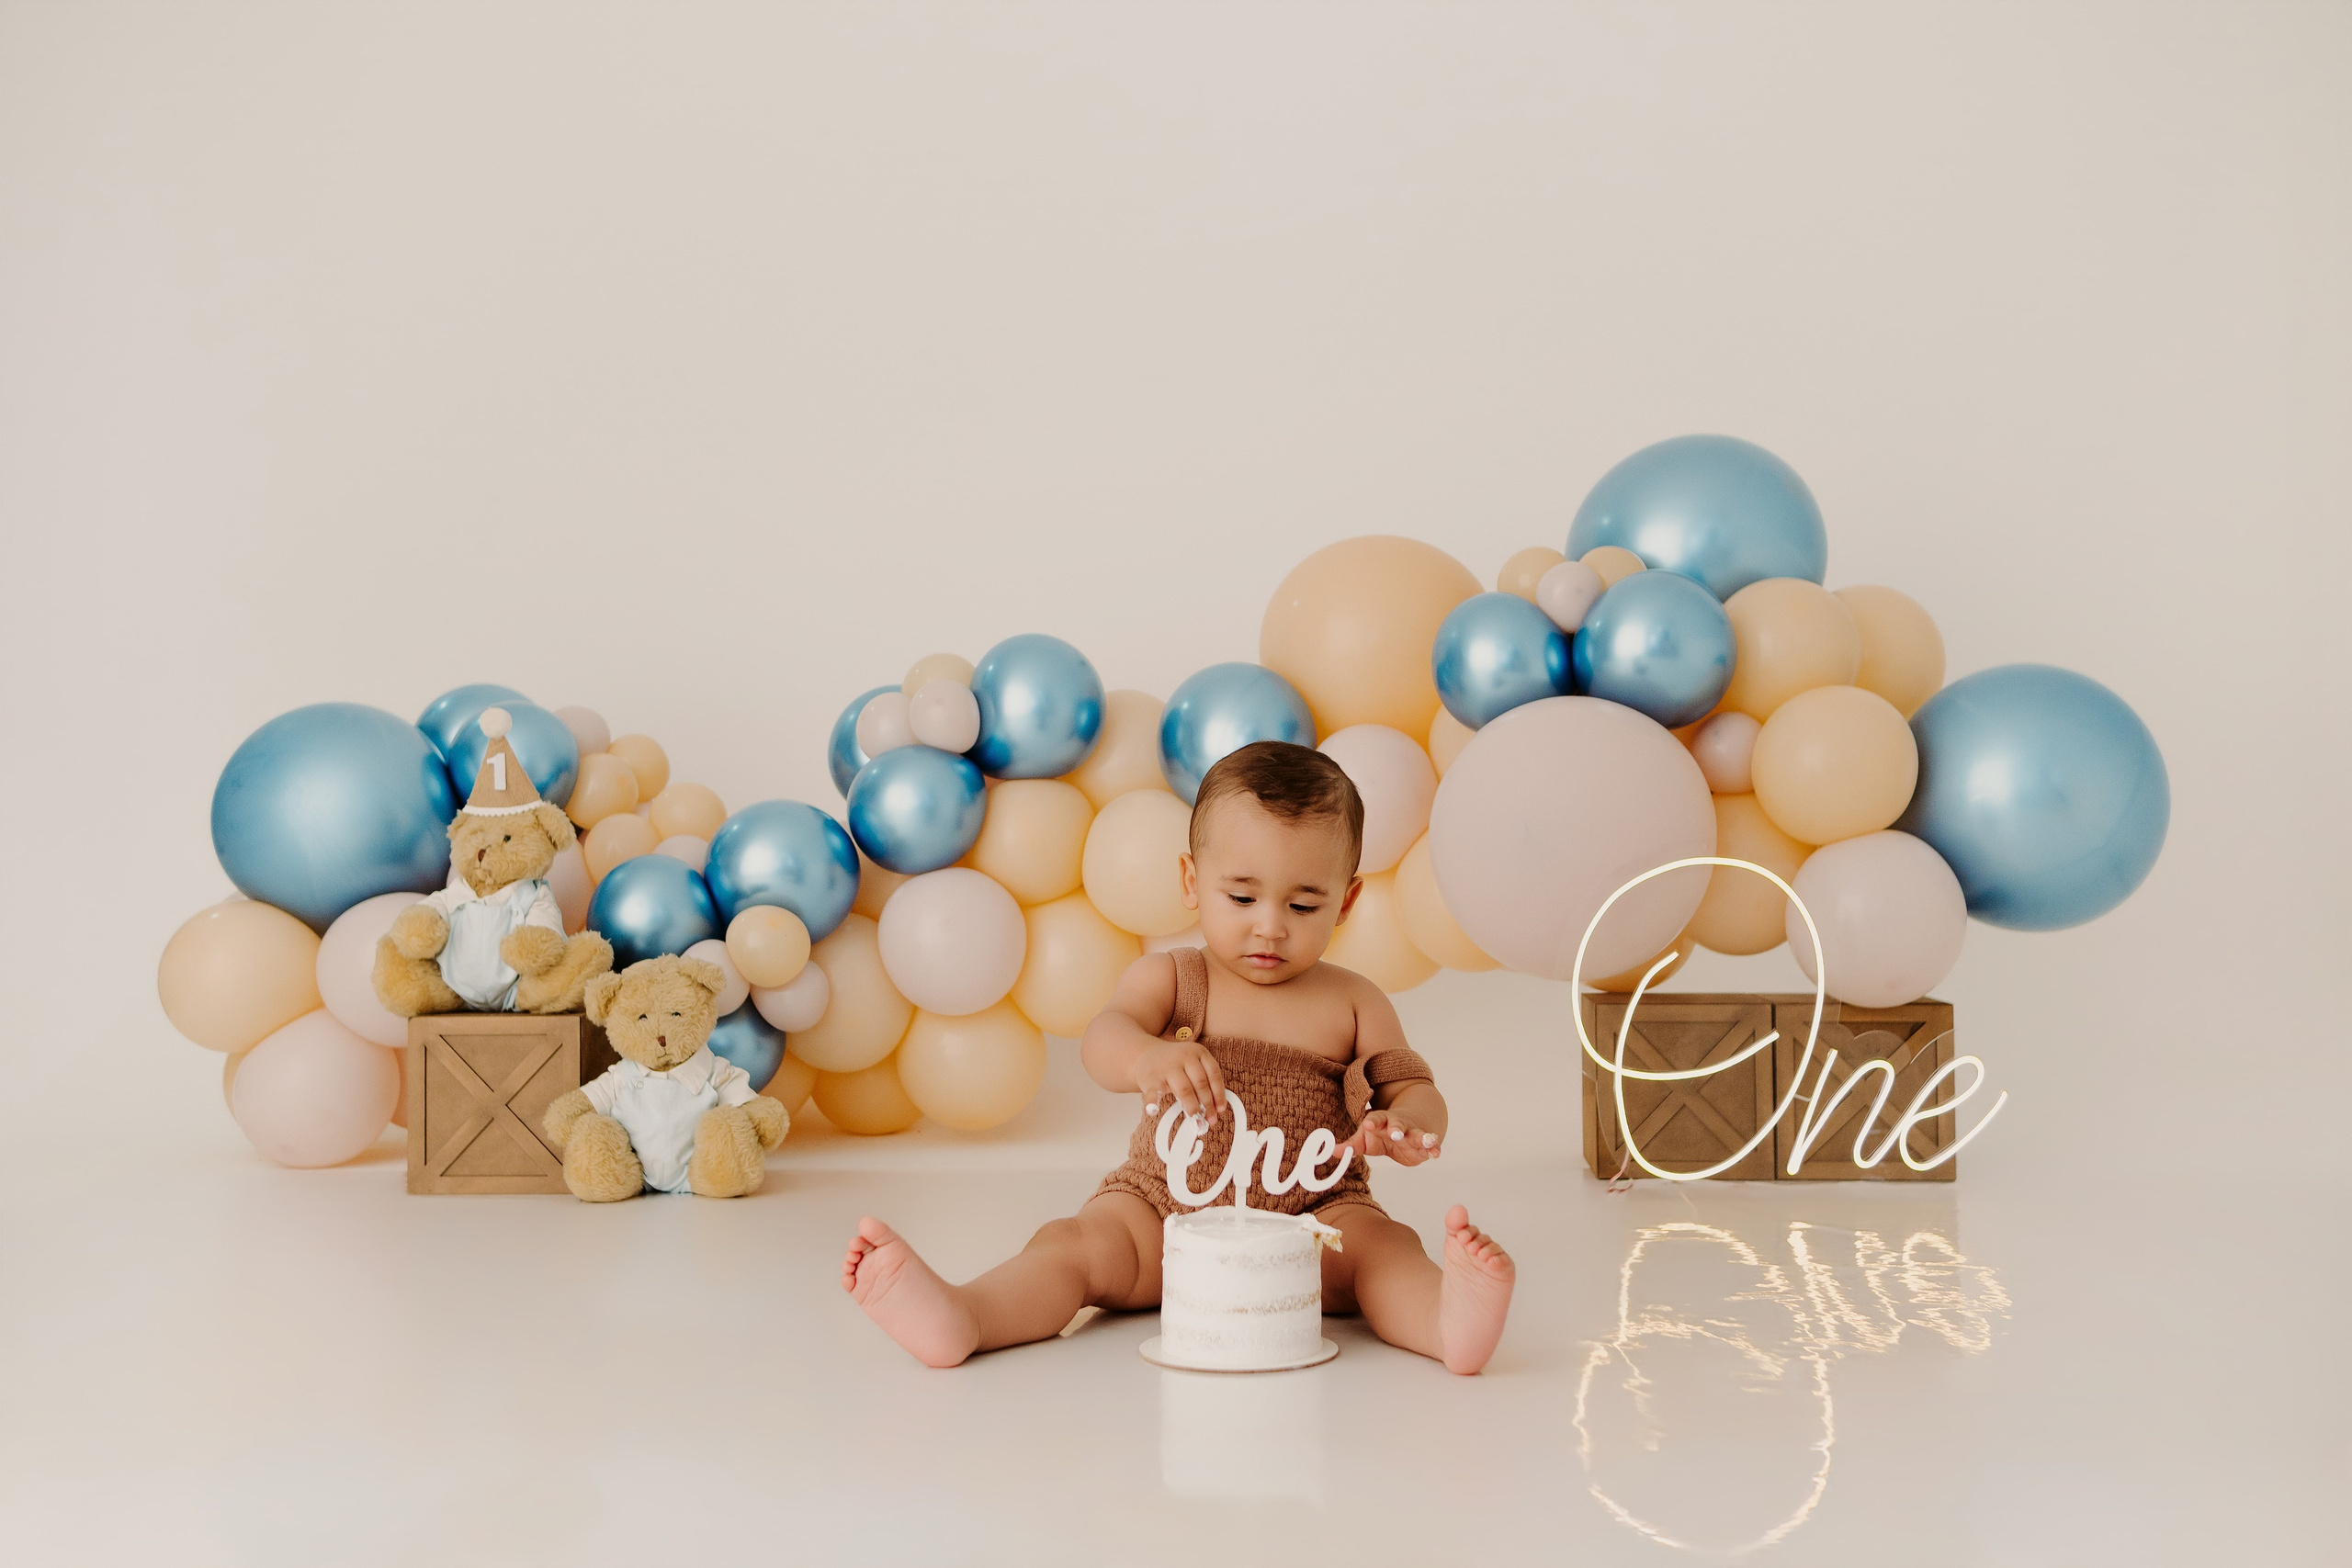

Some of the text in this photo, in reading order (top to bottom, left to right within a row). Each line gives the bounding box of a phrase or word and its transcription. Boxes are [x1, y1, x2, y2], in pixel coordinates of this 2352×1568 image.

[486, 751, 506, 791] 1
[1571, 855, 2008, 1181] One
[1155, 1089, 1354, 1207] One
